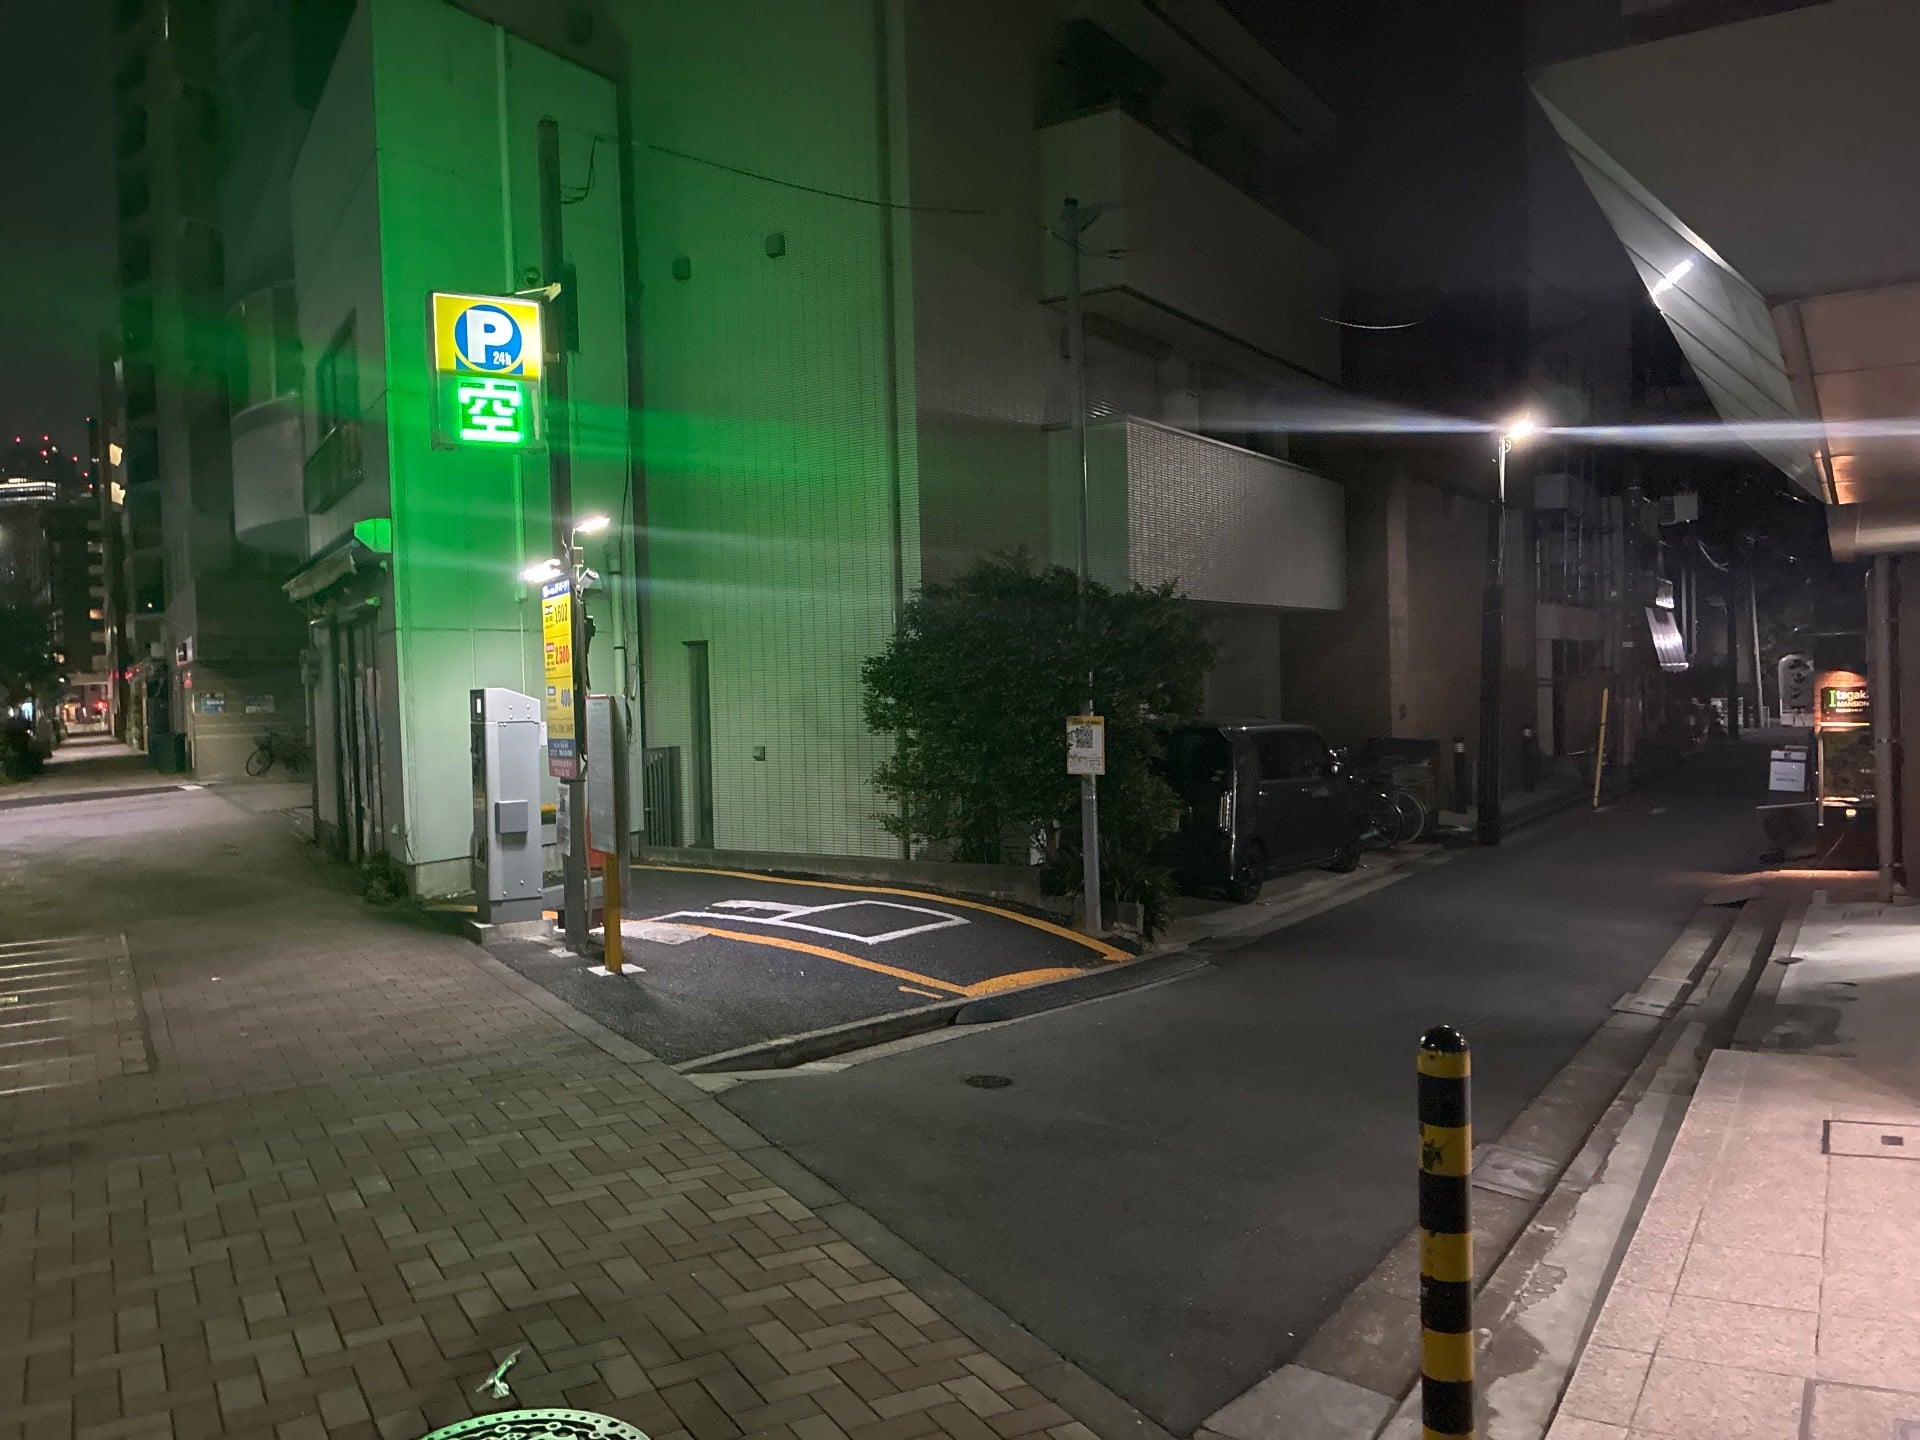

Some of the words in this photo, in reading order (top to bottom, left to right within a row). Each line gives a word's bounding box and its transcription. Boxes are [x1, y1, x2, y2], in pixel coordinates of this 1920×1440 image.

[466, 309, 514, 364] P
[492, 351, 512, 366] 24h
[458, 378, 522, 443] 空
